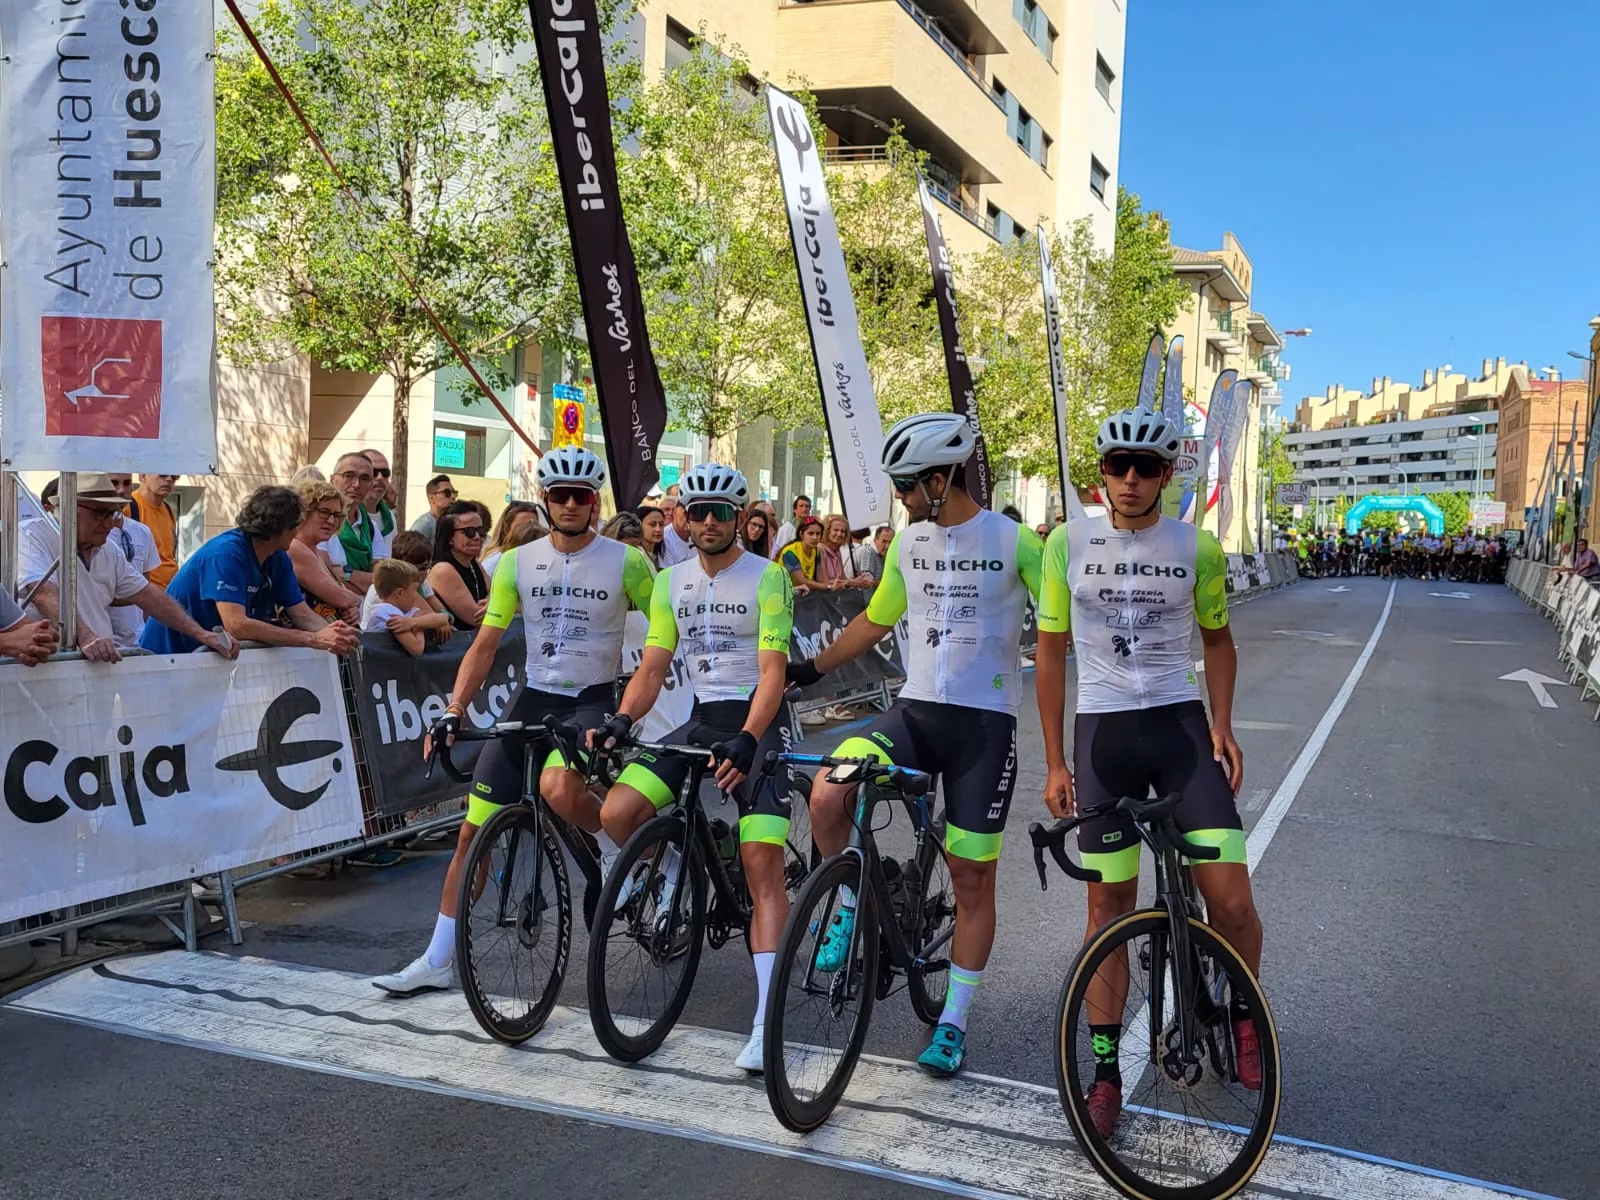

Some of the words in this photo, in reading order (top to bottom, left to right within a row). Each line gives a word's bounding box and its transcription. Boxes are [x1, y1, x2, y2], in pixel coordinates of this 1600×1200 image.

[44, 0, 106, 297] Ayuntami
[113, 233, 163, 300] de
[627, 358, 637, 394] DEL
[631, 400, 652, 461] BANCO
[848, 424, 861, 447] DEL
[976, 444, 985, 461] DEL
[856, 451, 874, 494] BANCO
[978, 464, 988, 500] BANCO
[868, 497, 877, 512] EL
[912, 558, 930, 570] EL
[935, 559, 1004, 572] BICHO
[1084, 563, 1107, 575] EL
[1114, 562, 1187, 578] BICHO
[531, 586, 547, 598] EL
[552, 586, 609, 601] BICHO
[678, 607, 691, 619] EL
[696, 603, 748, 615] BICHO
[987, 798, 1005, 819] EL
